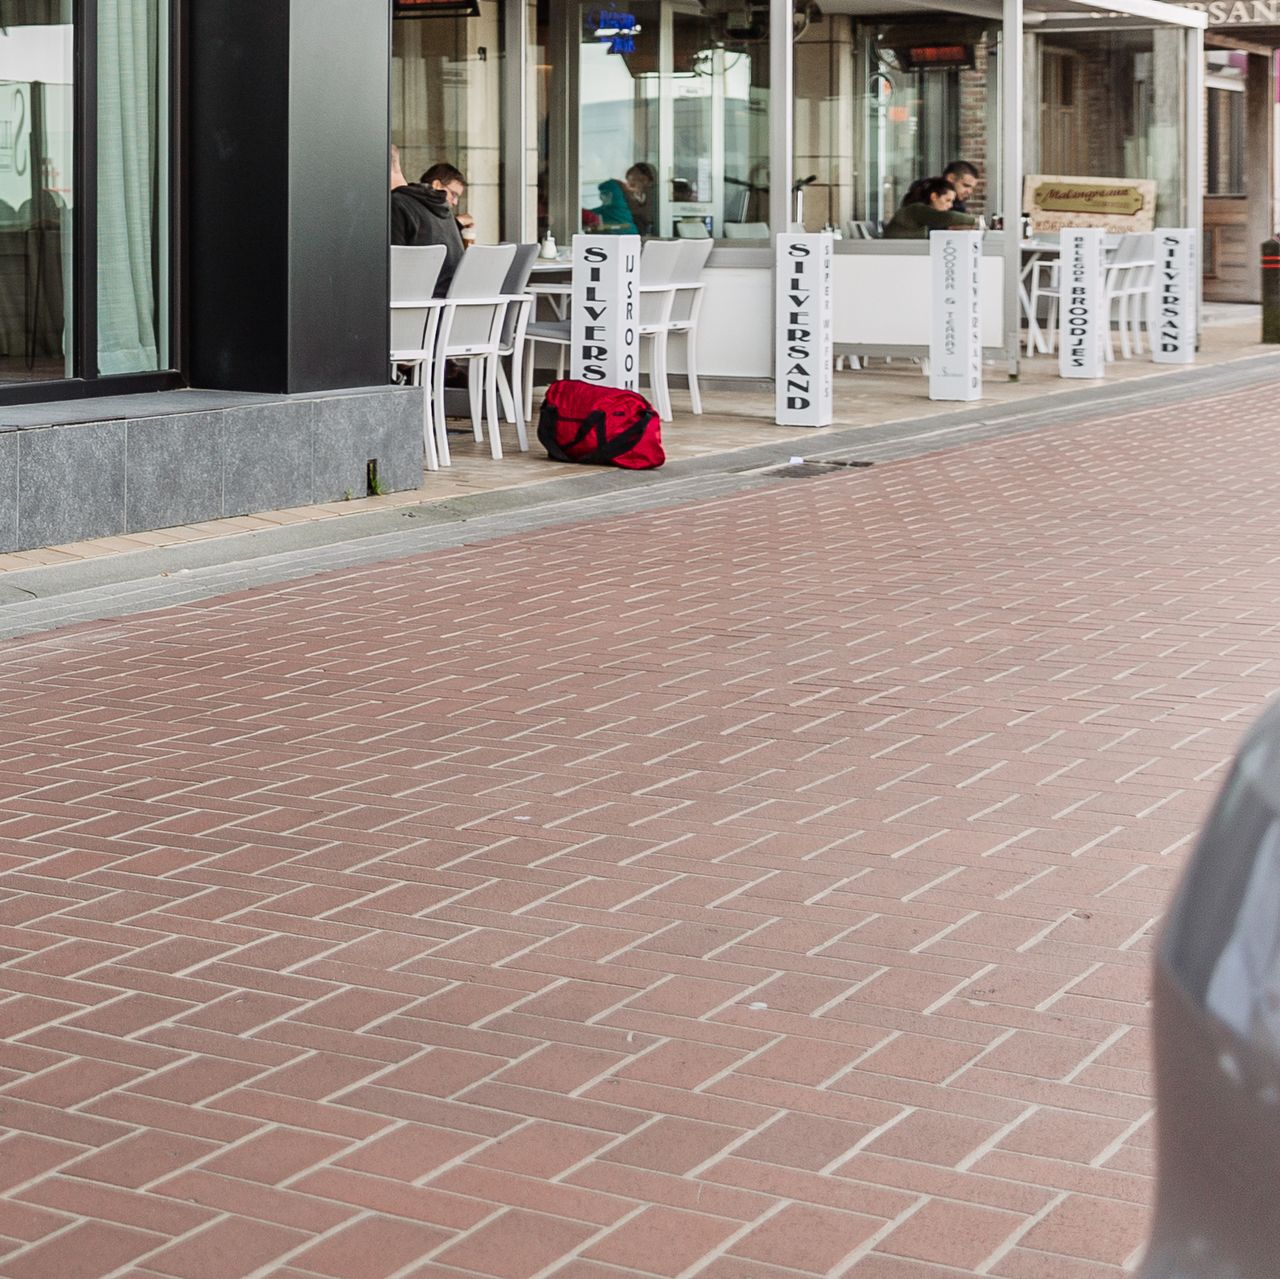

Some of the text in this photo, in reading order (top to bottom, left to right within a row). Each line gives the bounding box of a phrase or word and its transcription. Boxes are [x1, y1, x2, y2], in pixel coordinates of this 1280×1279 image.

[1182, 0, 1280, 25] SAN
[582, 246, 608, 381] SILVERS
[786, 243, 811, 410] SILVERSAND
[1069, 236, 1088, 368] BELEGDE BROODJES
[1161, 235, 1180, 353] SILVERSAND
